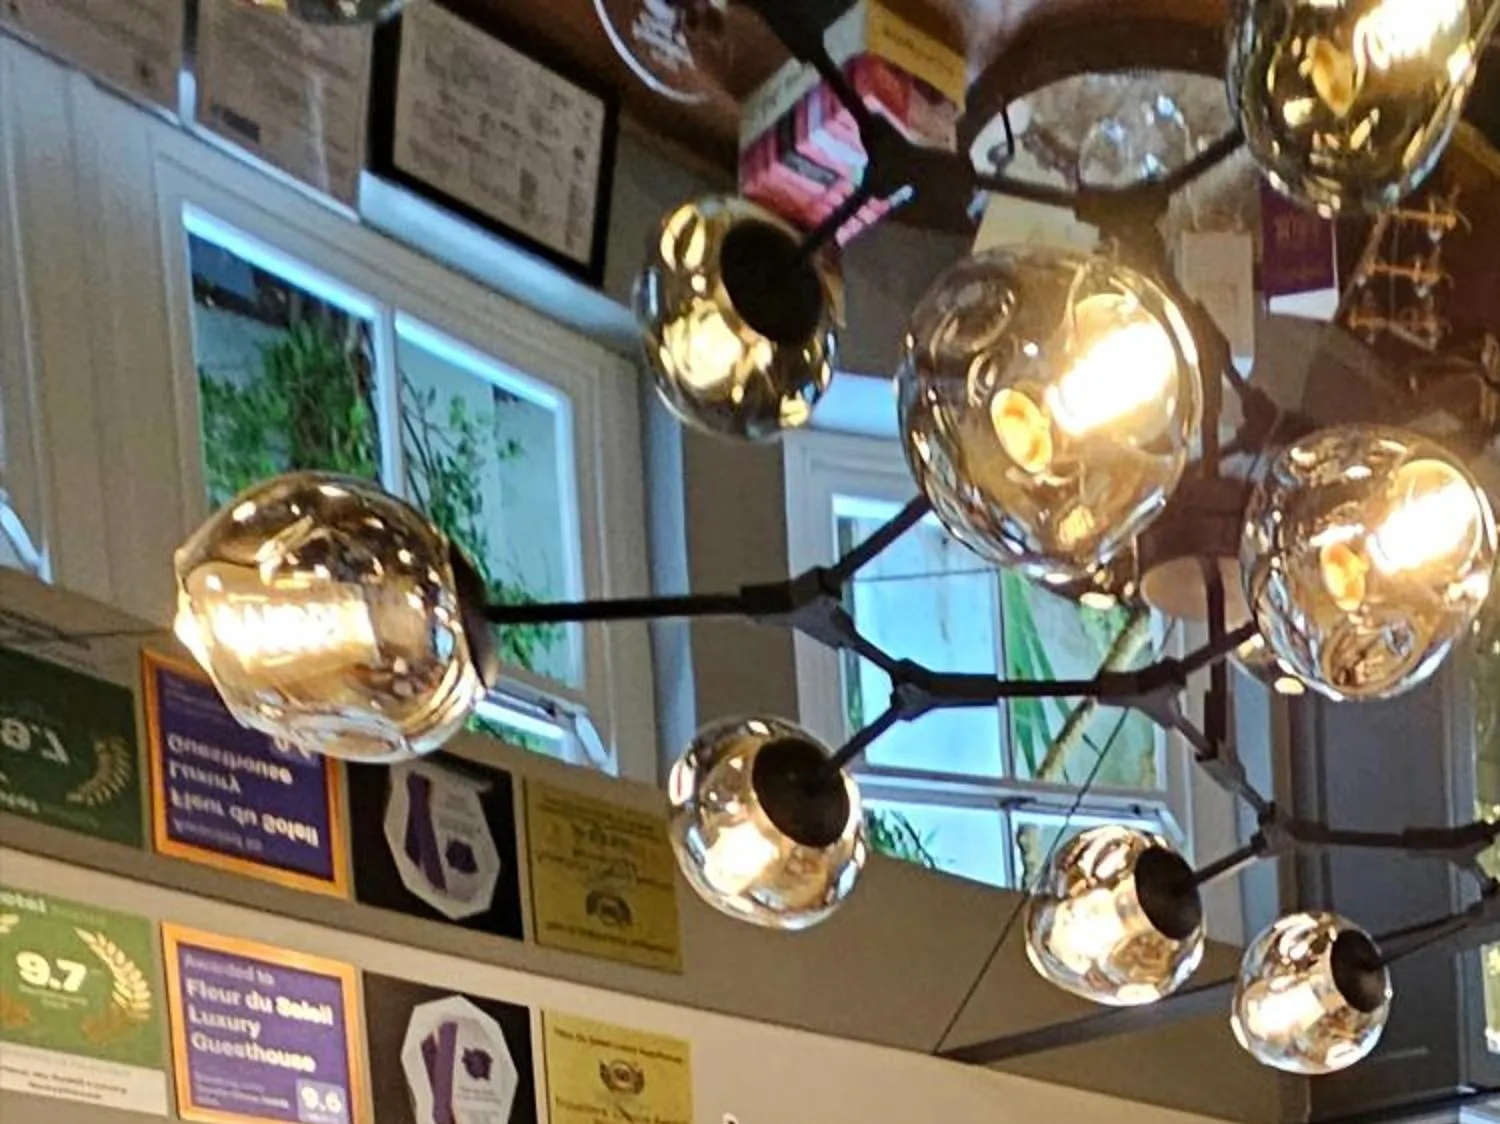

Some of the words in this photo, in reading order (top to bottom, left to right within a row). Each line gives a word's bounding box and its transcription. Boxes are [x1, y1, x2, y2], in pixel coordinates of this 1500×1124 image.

[16, 951, 87, 993] 9.7
[186, 978, 241, 1006] Fleur
[245, 990, 273, 1014] du
[275, 996, 335, 1026] Soleil
[188, 1003, 262, 1039] Luxury
[191, 1032, 317, 1074] Guesthouse
[301, 1086, 342, 1114] 9.6
